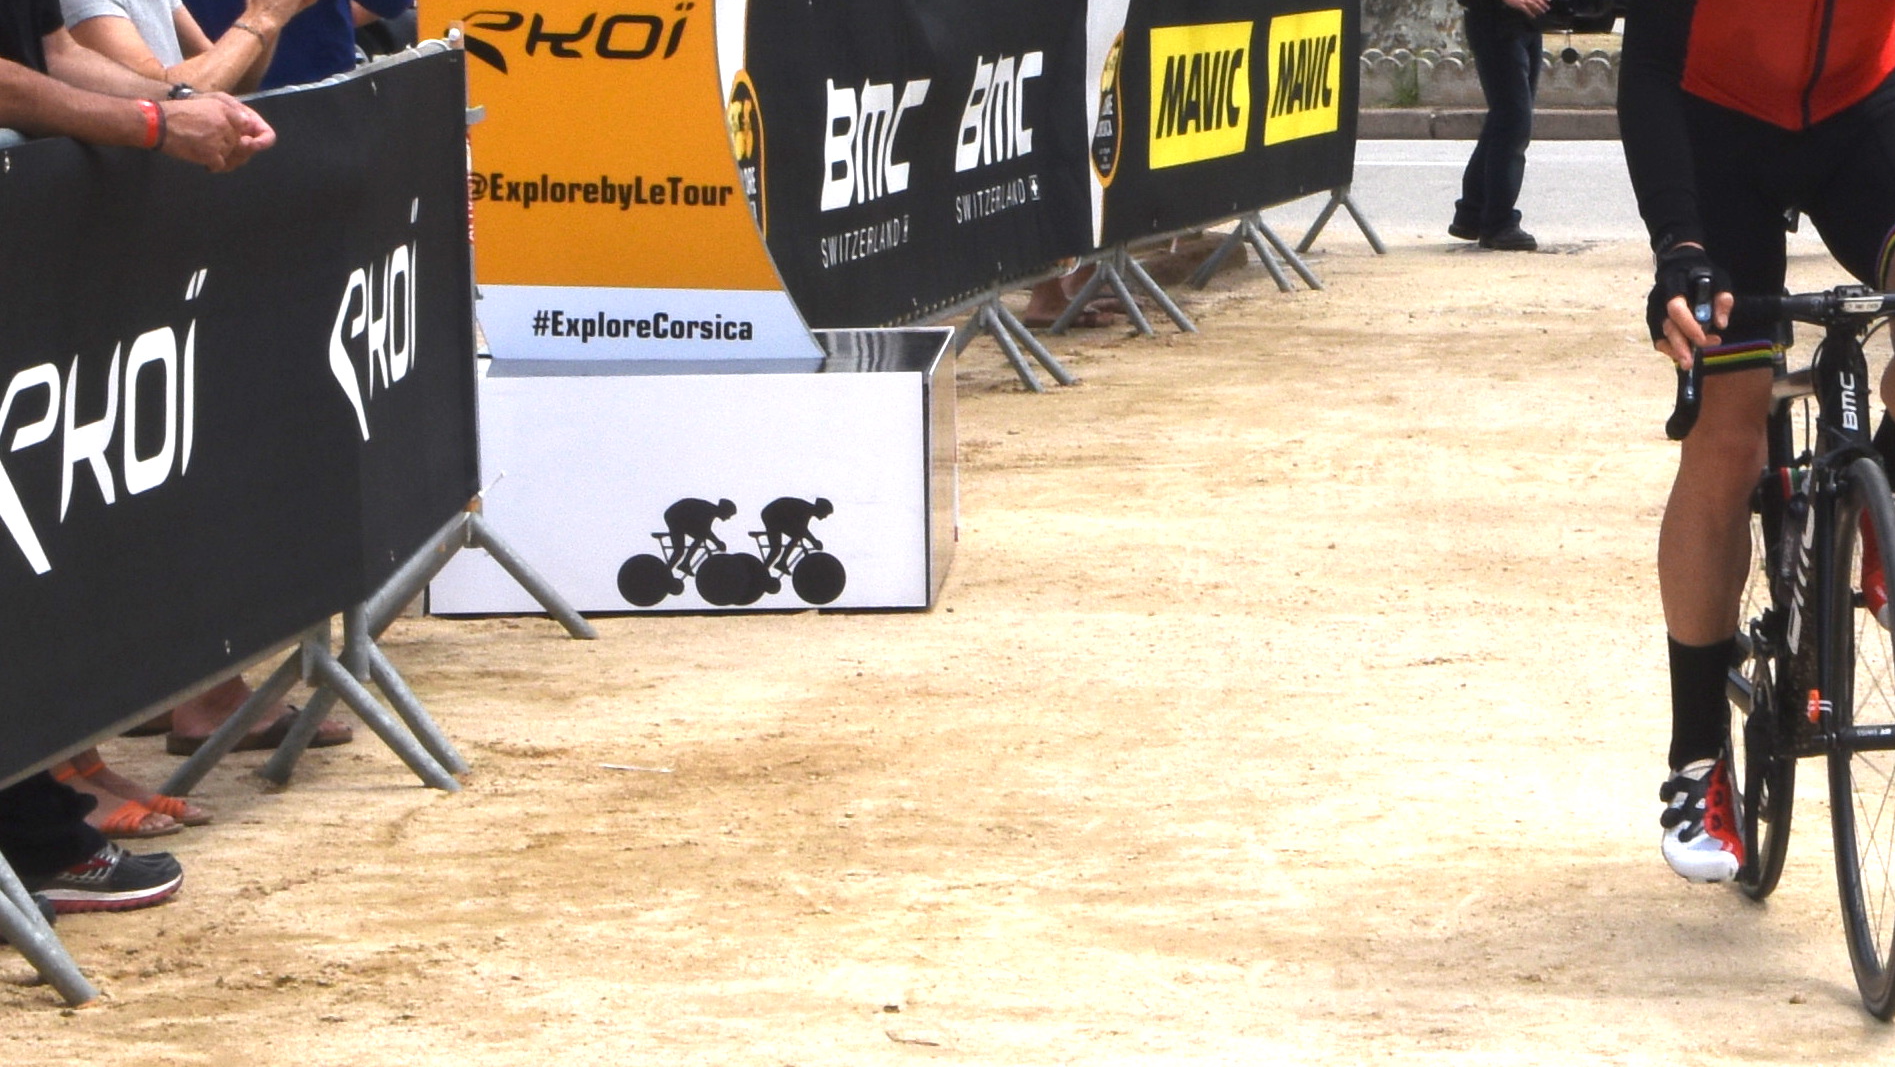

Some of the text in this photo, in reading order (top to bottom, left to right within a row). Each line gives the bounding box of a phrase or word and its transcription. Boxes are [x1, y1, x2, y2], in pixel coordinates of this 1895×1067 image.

[1156, 46, 1245, 140] MAVIC
[1270, 32, 1337, 119] MAVIC
[955, 50, 1043, 172] BMC
[820, 78, 930, 212] BMC
[468, 173, 733, 211] @ExplorebyLeTour
[956, 178, 1026, 225] SWITZERLAND
[821, 219, 900, 269] SWITZERLAND
[533, 311, 753, 344] #ExploreCorsica
[1839, 372, 1858, 430] BMC
